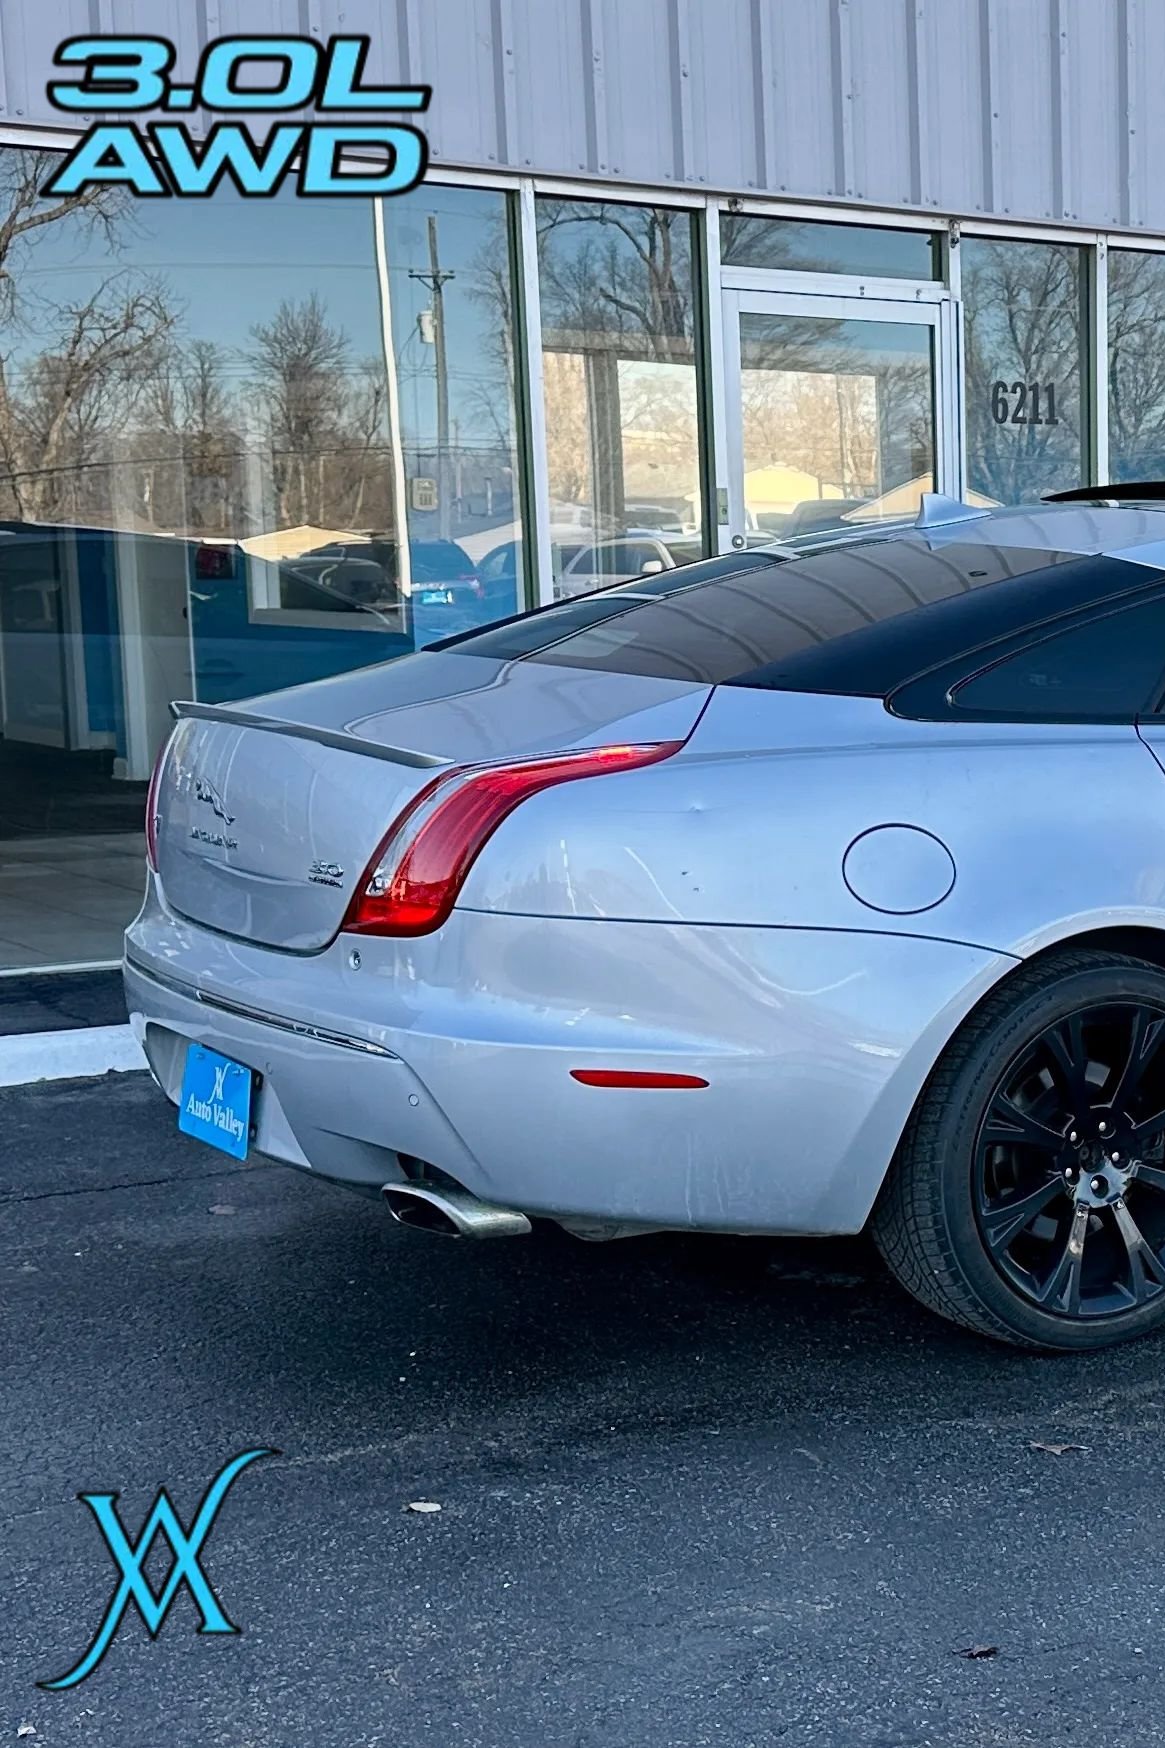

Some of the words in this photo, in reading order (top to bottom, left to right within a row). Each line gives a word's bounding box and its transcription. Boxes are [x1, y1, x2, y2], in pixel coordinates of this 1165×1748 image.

[992, 381, 1058, 424] 6211
[186, 1093, 213, 1122] Auto
[213, 1103, 245, 1142] Valley
